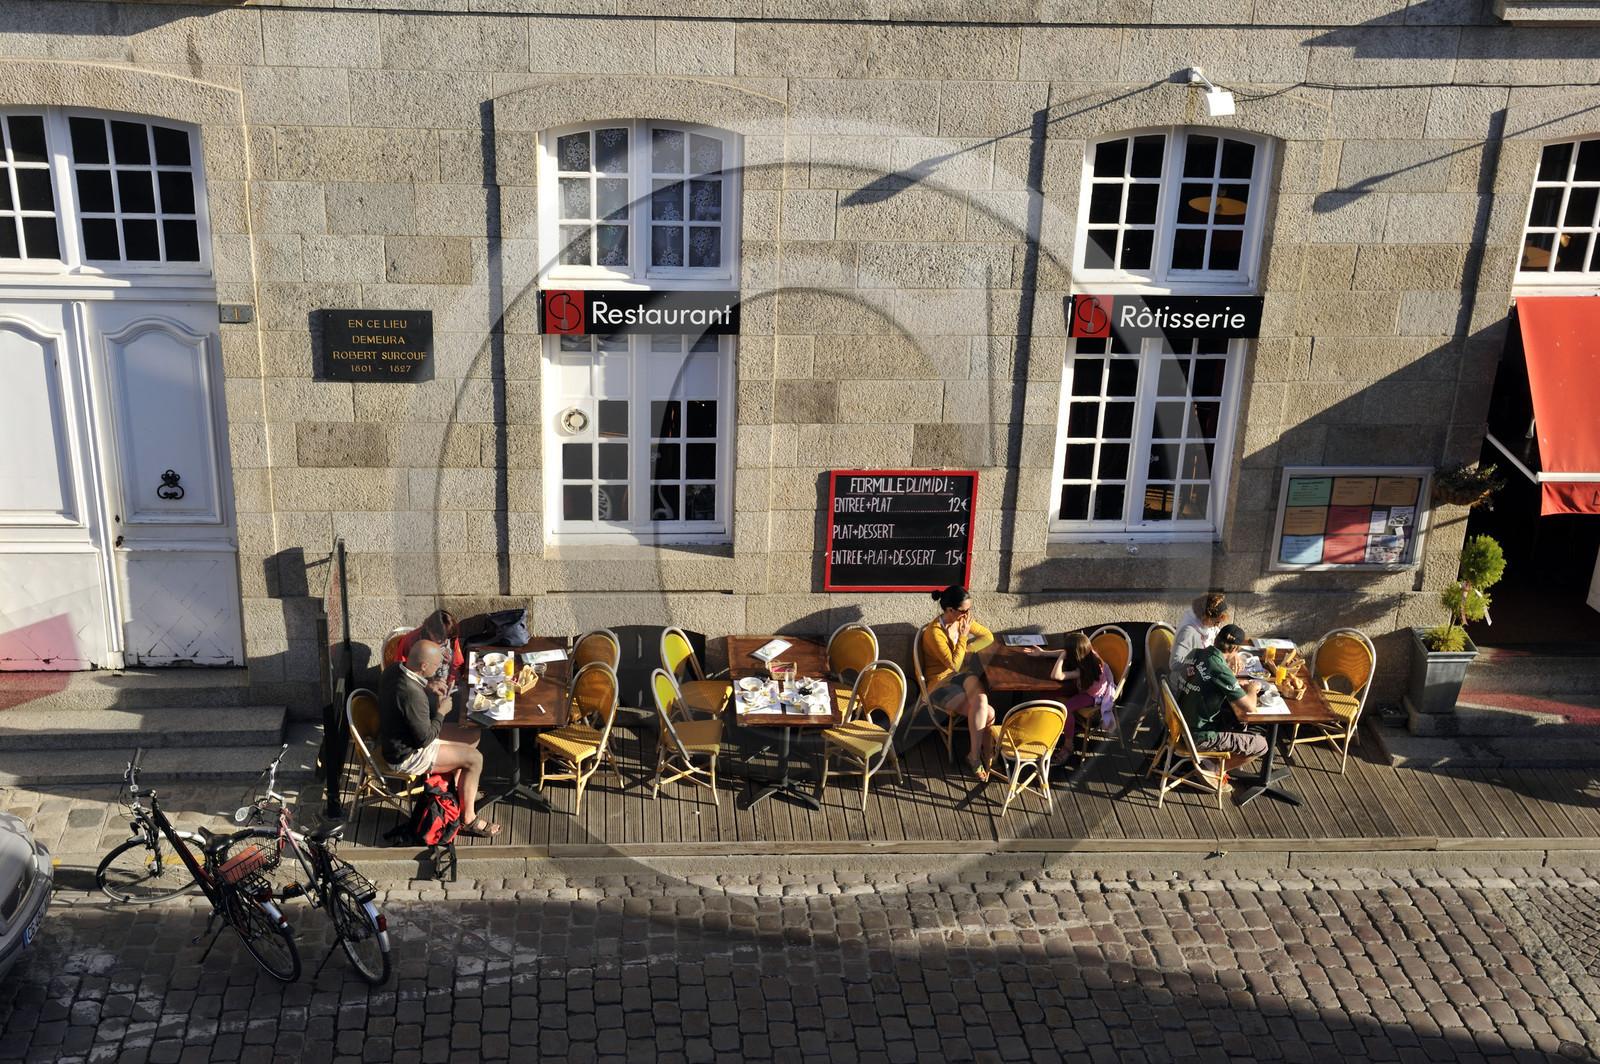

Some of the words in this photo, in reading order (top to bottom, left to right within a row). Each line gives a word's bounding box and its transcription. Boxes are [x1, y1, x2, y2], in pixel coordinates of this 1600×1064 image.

[234, 307, 239, 320] 1
[592, 300, 732, 325] Restaurant
[1120, 305, 1246, 329] Rôtisserie
[348, 319, 363, 328] EN
[366, 319, 380, 328] CE
[383, 319, 407, 328] LIEU
[352, 335, 405, 344] DEMEURA
[332, 351, 377, 360] ROBERT
[381, 351, 427, 360] SURCOUF
[850, 477, 905, 493] FORMULE
